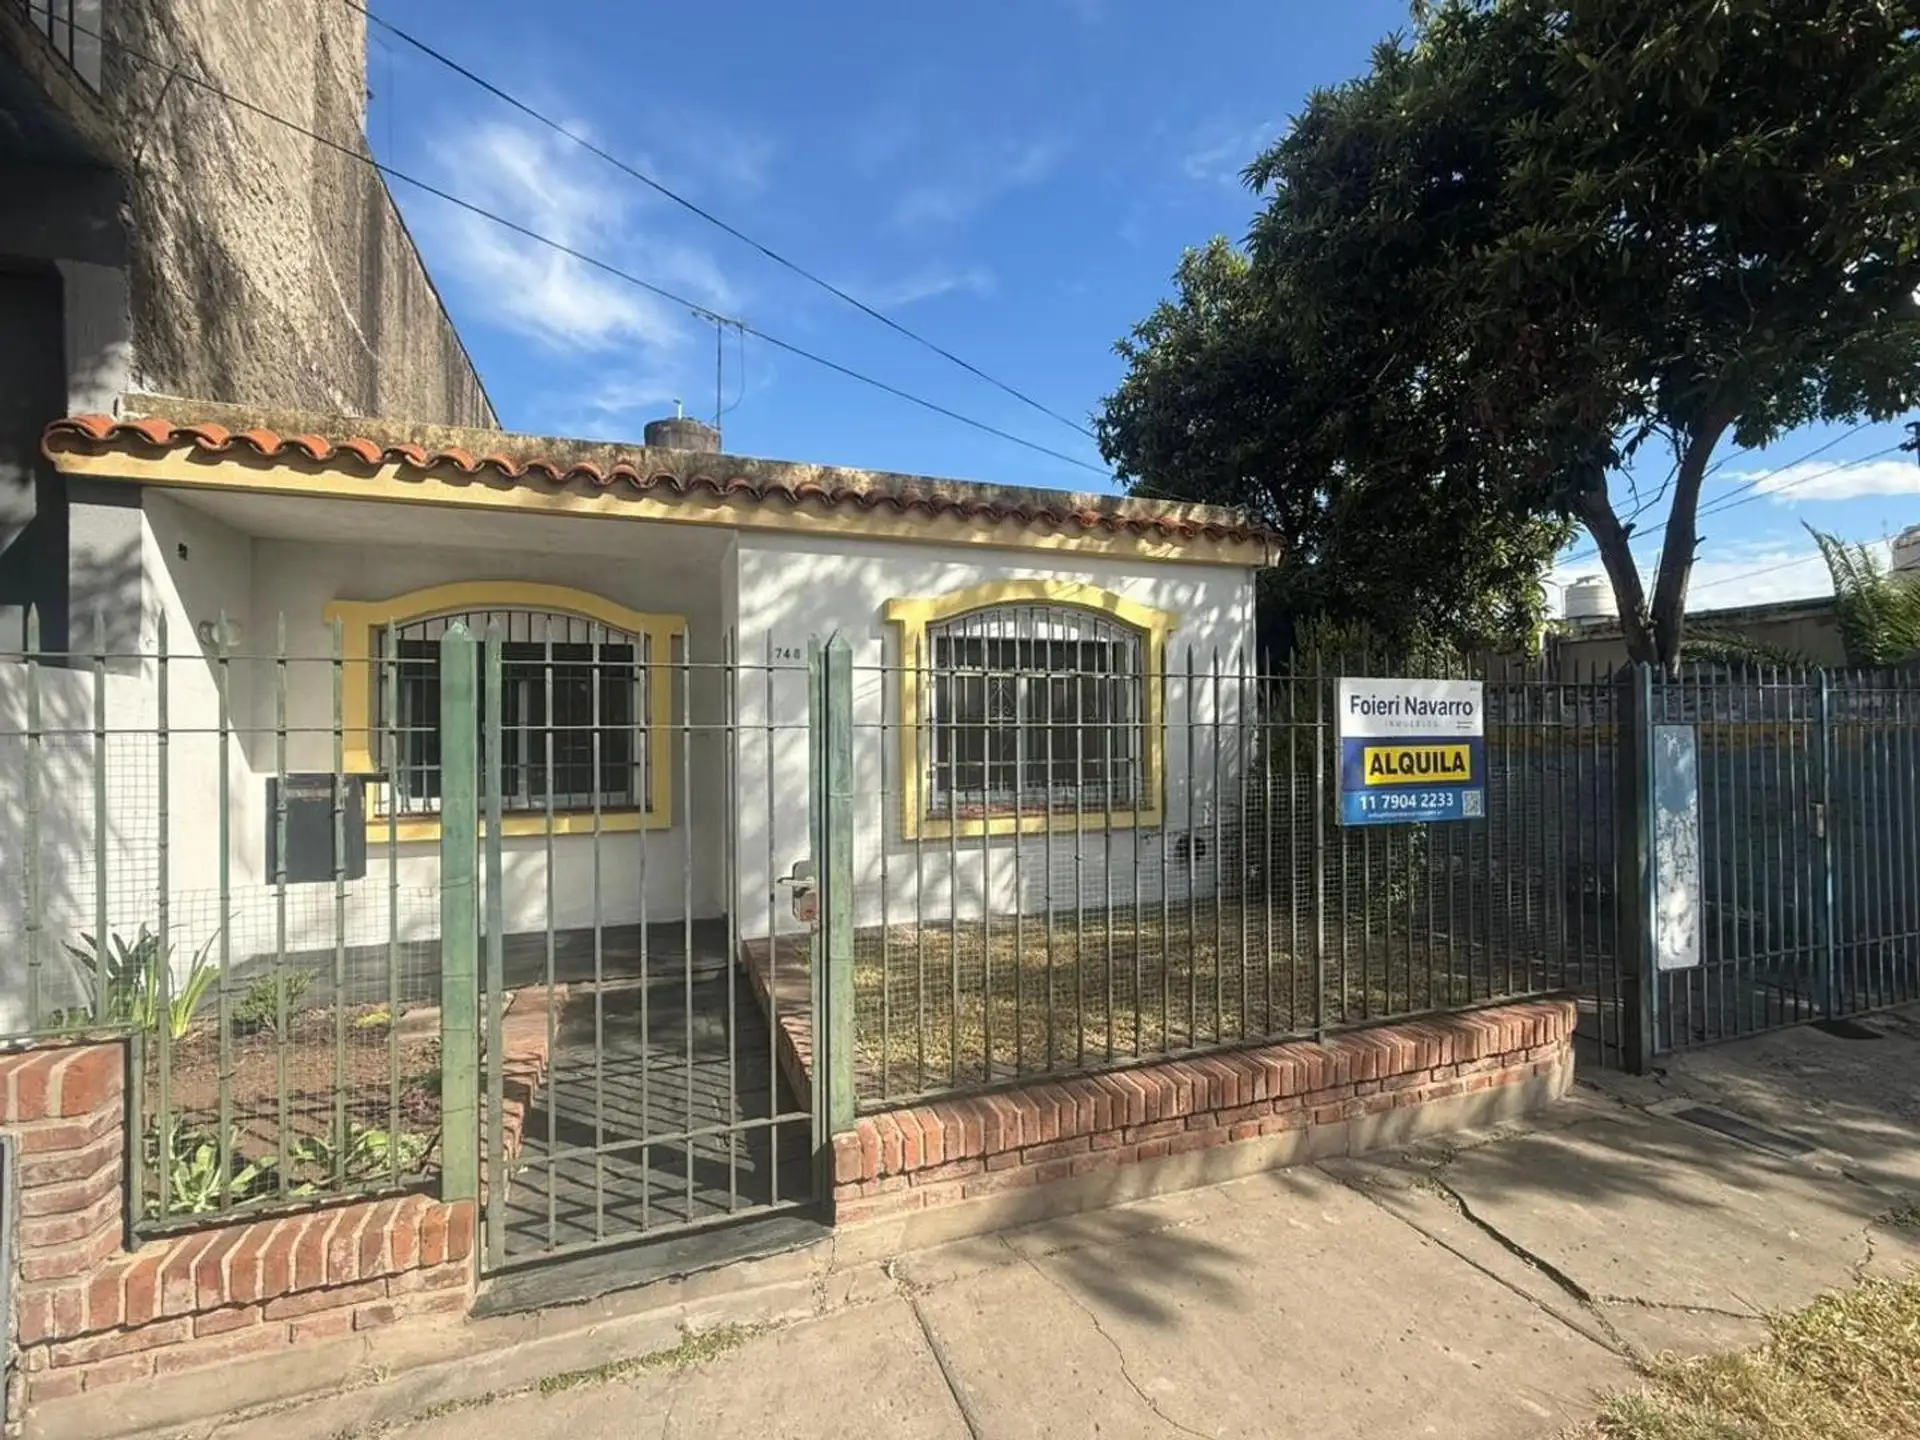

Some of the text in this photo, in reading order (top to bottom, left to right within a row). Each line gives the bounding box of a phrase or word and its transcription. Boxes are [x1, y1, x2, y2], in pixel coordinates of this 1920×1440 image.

[1350, 694, 1473, 716] Foieri Navarro
[1370, 751, 1466, 776] ALQUILA
[1360, 792, 1454, 810] 11 7904 2233
